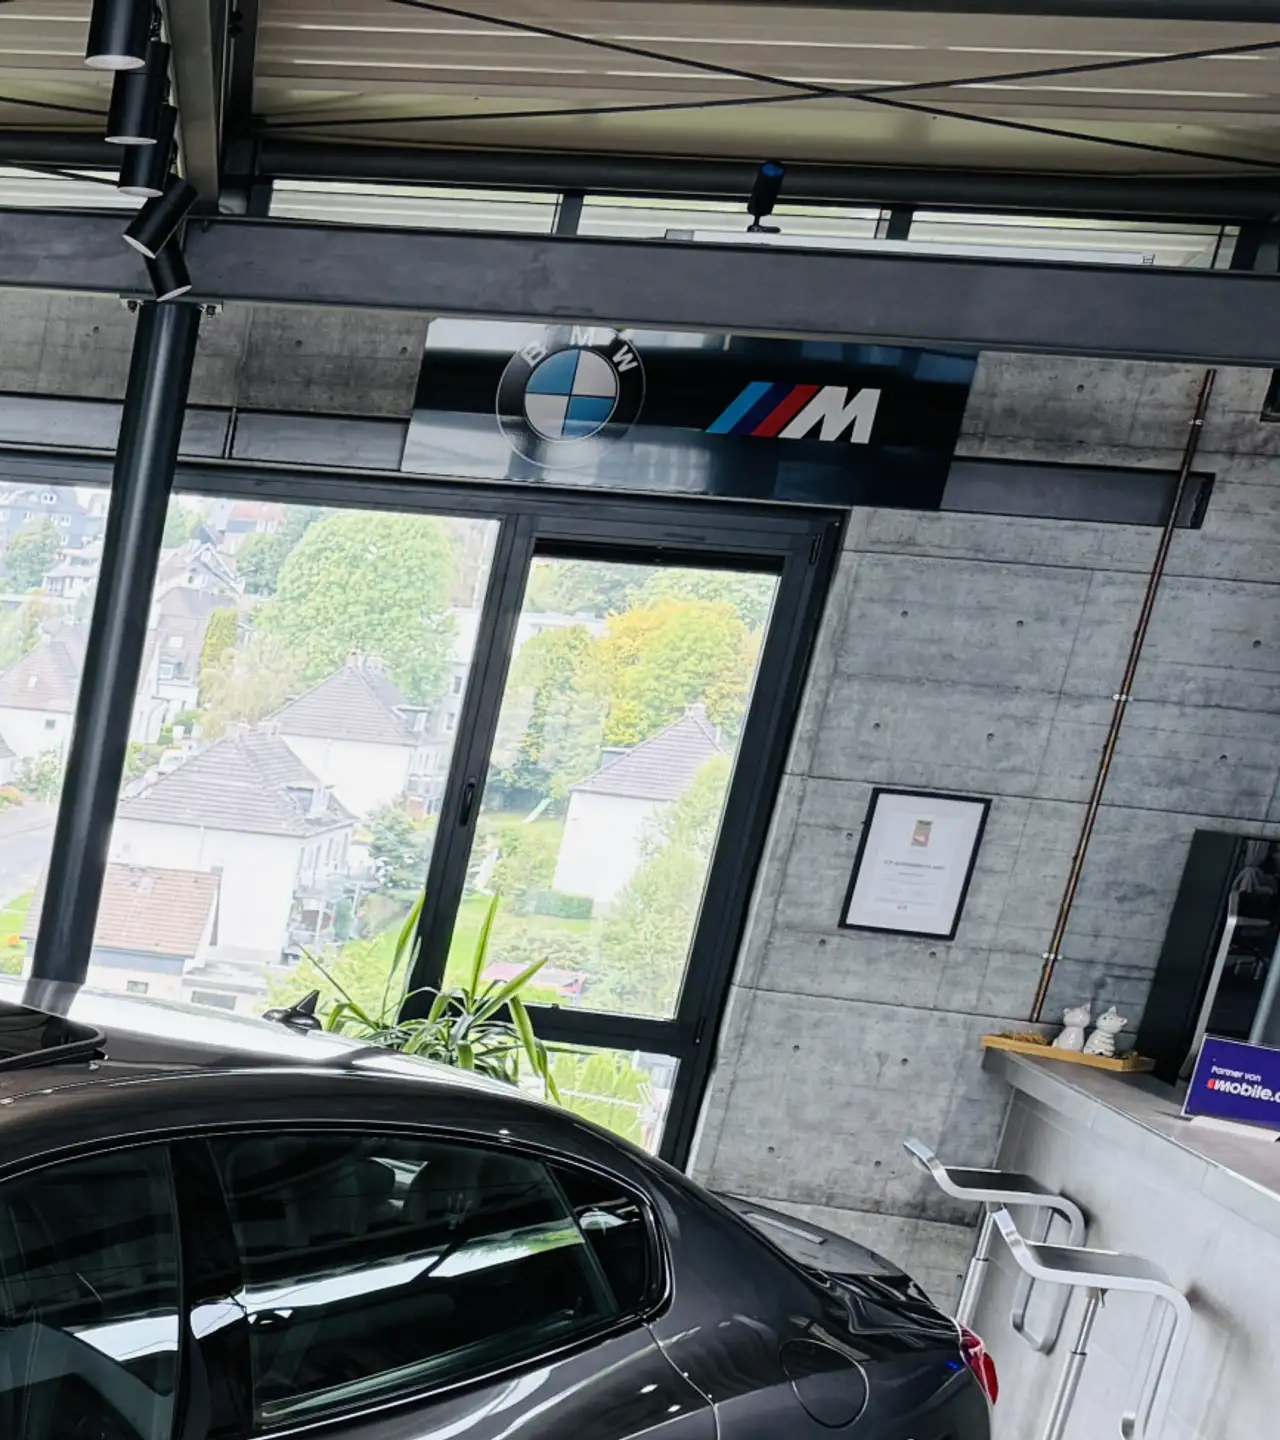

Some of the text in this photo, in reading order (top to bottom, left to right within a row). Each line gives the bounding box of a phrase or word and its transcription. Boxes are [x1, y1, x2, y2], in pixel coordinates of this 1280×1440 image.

[520, 324, 639, 374] BMW
[777, 385, 882, 445] M
[1244, 1071, 1262, 1083] von
